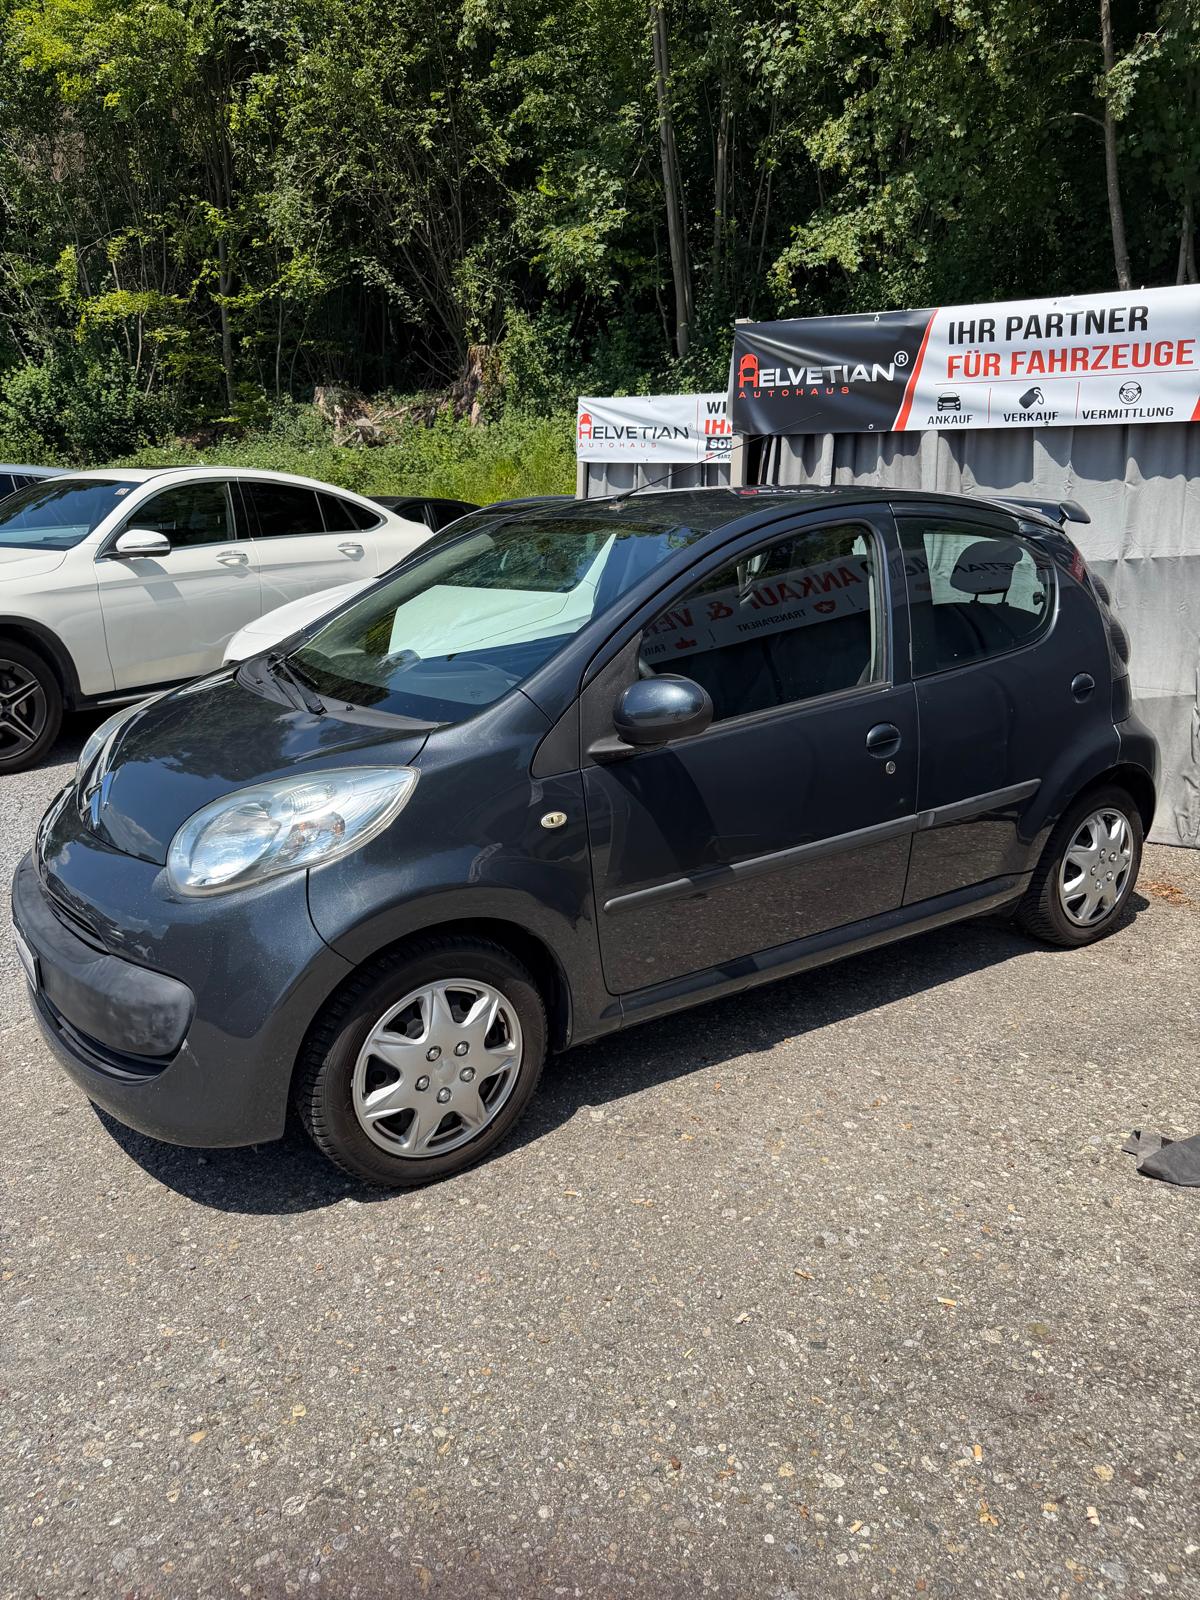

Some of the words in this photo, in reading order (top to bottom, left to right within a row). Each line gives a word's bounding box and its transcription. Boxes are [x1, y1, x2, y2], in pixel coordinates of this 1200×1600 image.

[949, 318, 996, 345] IHR
[1005, 305, 1149, 341] PARTNER
[947, 350, 1001, 378] FÜR
[1010, 339, 1196, 375] FAHRZEUGE
[738, 386, 850, 399] AUTOHAUS
[706, 401, 727, 414] WI
[1082, 406, 1174, 420] VERMITTLUNG
[927, 414, 973, 424] ANKAUF
[1003, 411, 1059, 422] VERKAUF
